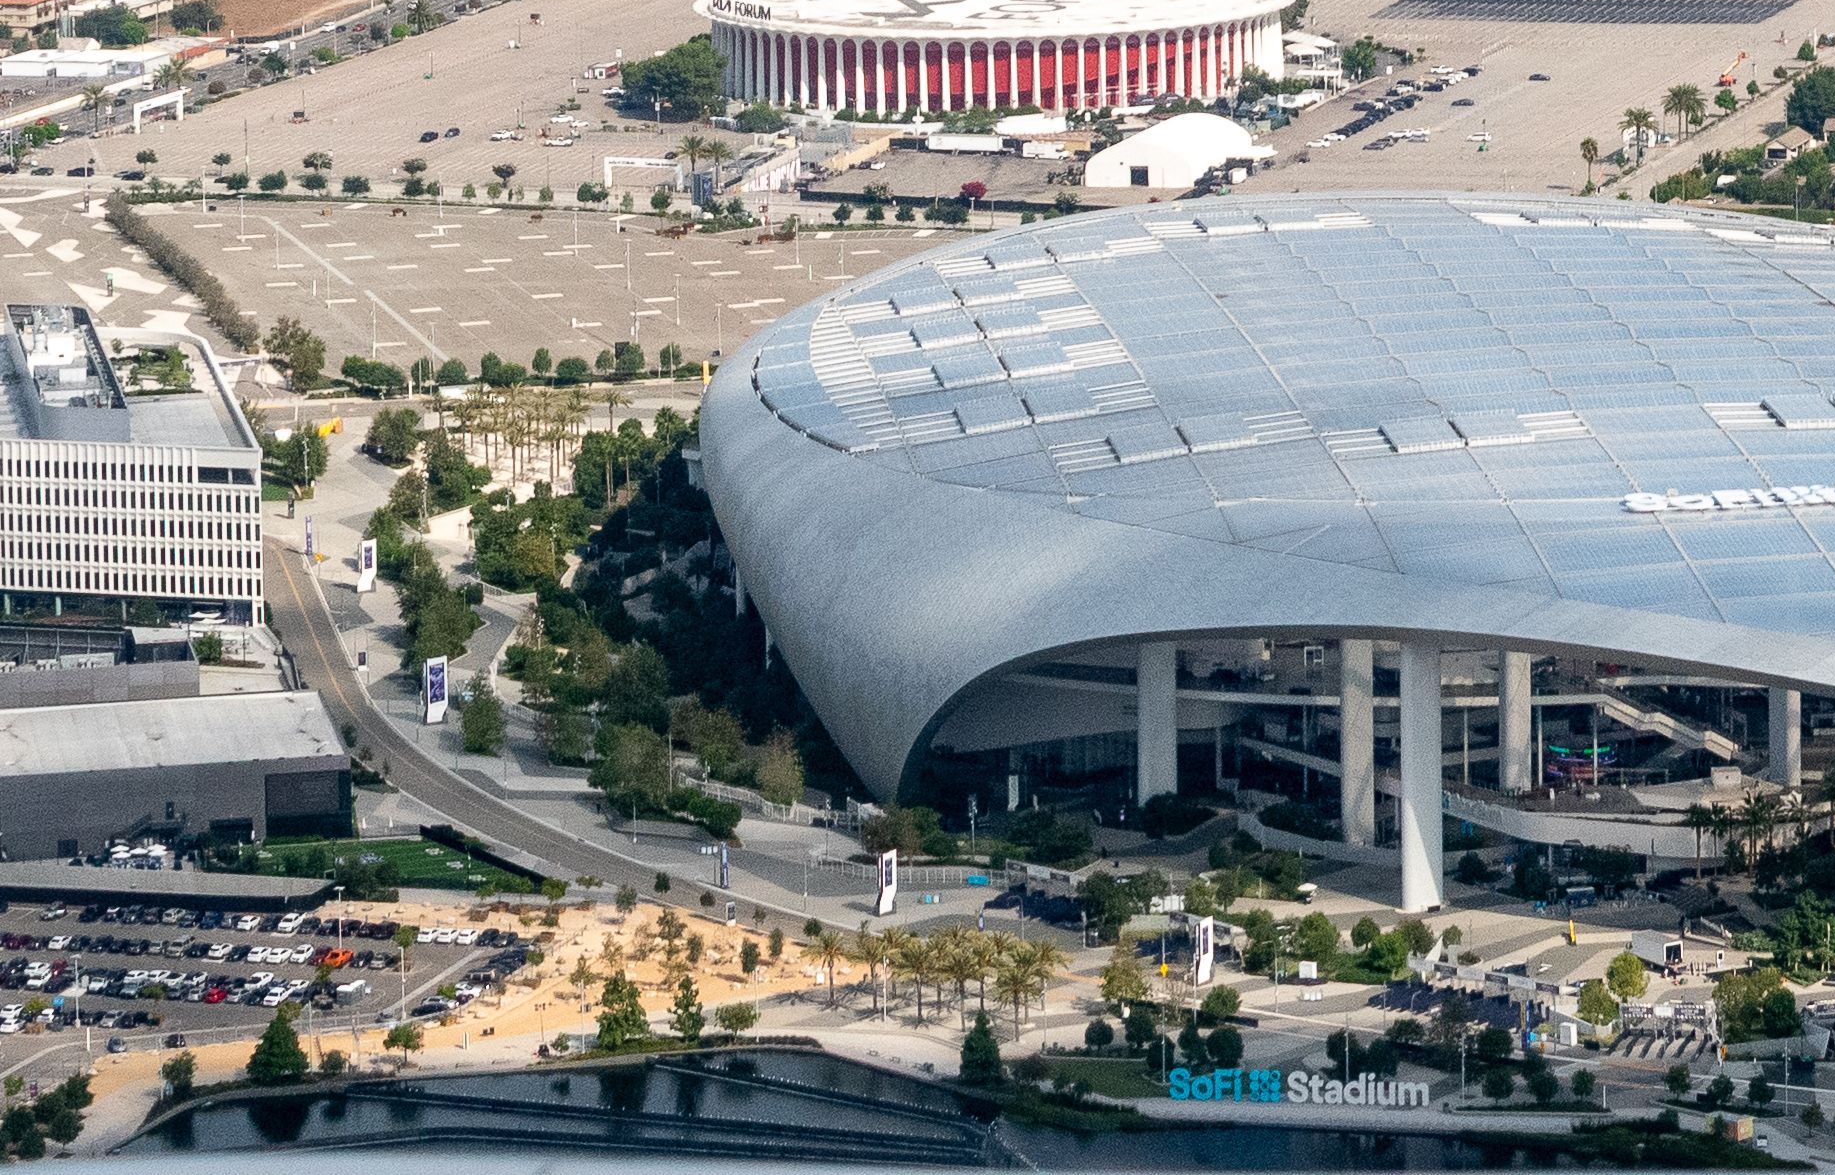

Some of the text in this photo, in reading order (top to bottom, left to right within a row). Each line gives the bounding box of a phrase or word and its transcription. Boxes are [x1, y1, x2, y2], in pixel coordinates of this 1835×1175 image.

[734, 1, 771, 21] FORUM
[1169, 1067, 1429, 1107] SoFi Stadium
